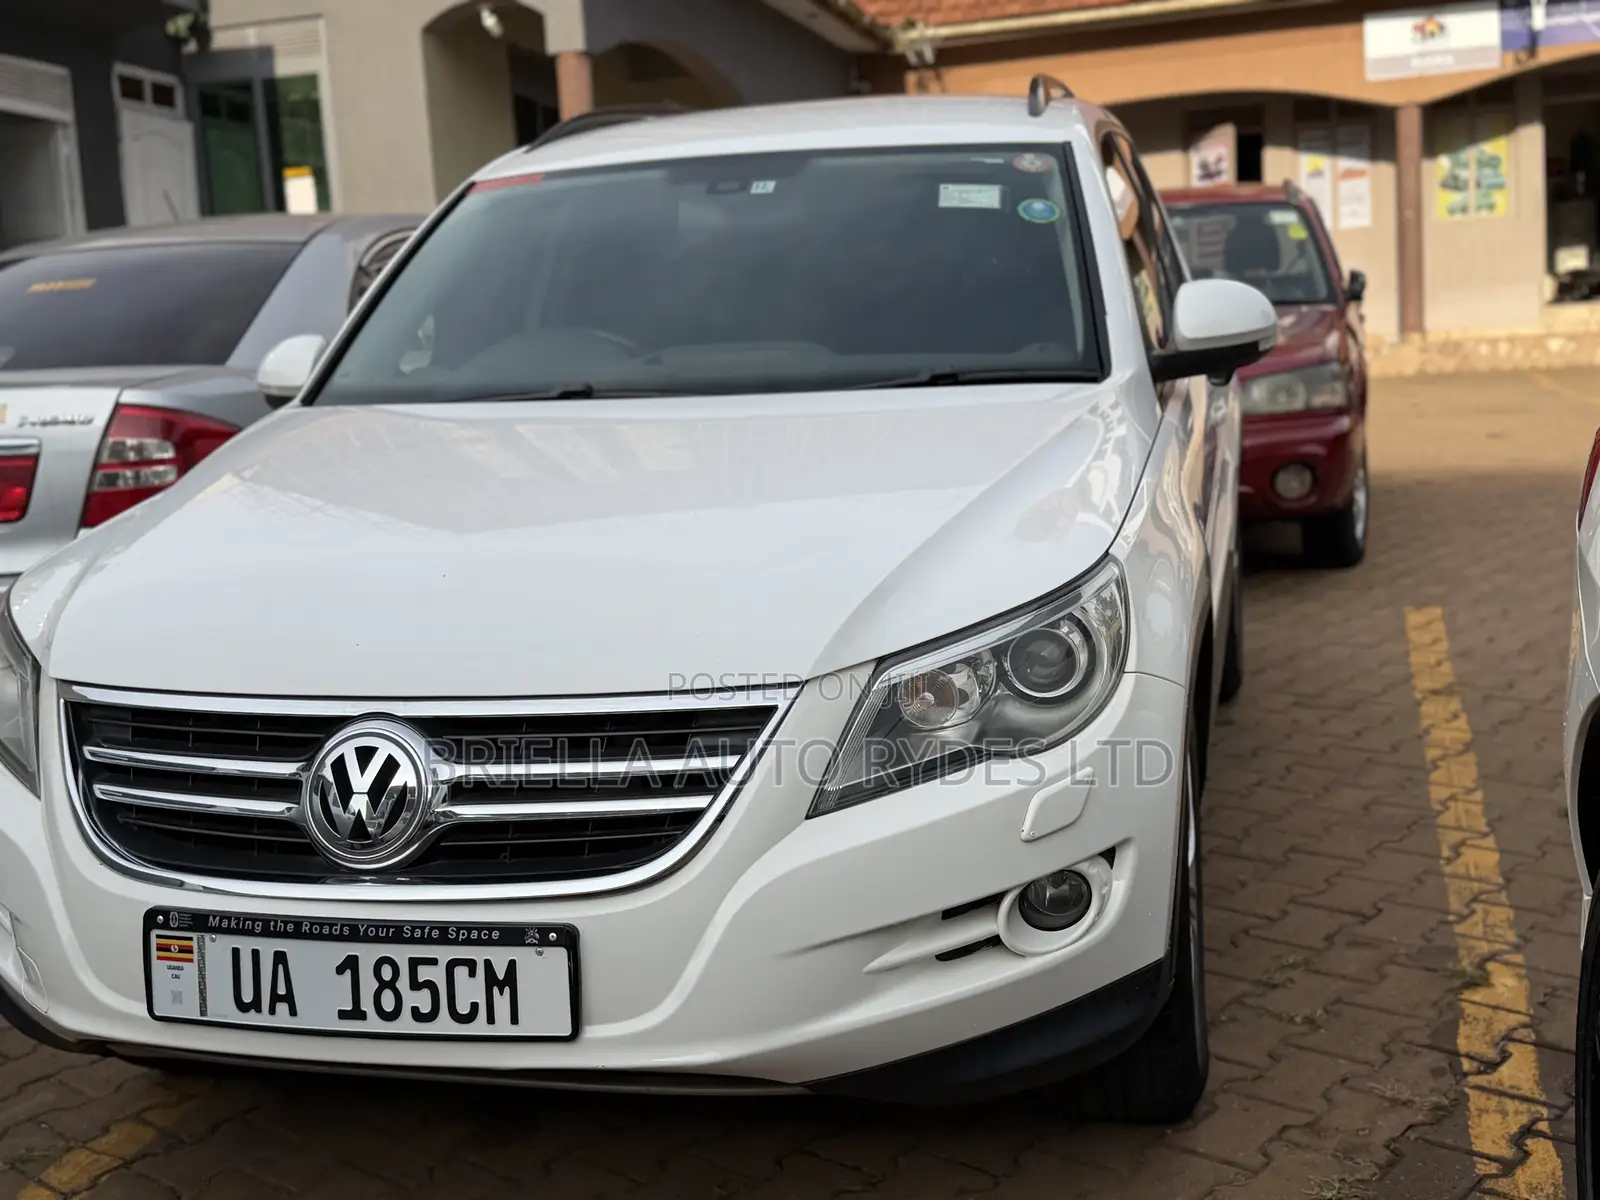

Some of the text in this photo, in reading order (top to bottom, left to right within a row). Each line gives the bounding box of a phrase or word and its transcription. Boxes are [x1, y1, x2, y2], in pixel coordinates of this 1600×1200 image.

[207, 915, 263, 933] Making
[269, 919, 295, 932] the
[301, 921, 350, 935] Roads
[358, 923, 396, 938] Your
[402, 925, 440, 939] Safe
[448, 926, 501, 942] Space
[231, 946, 520, 1026] UA 185CM
